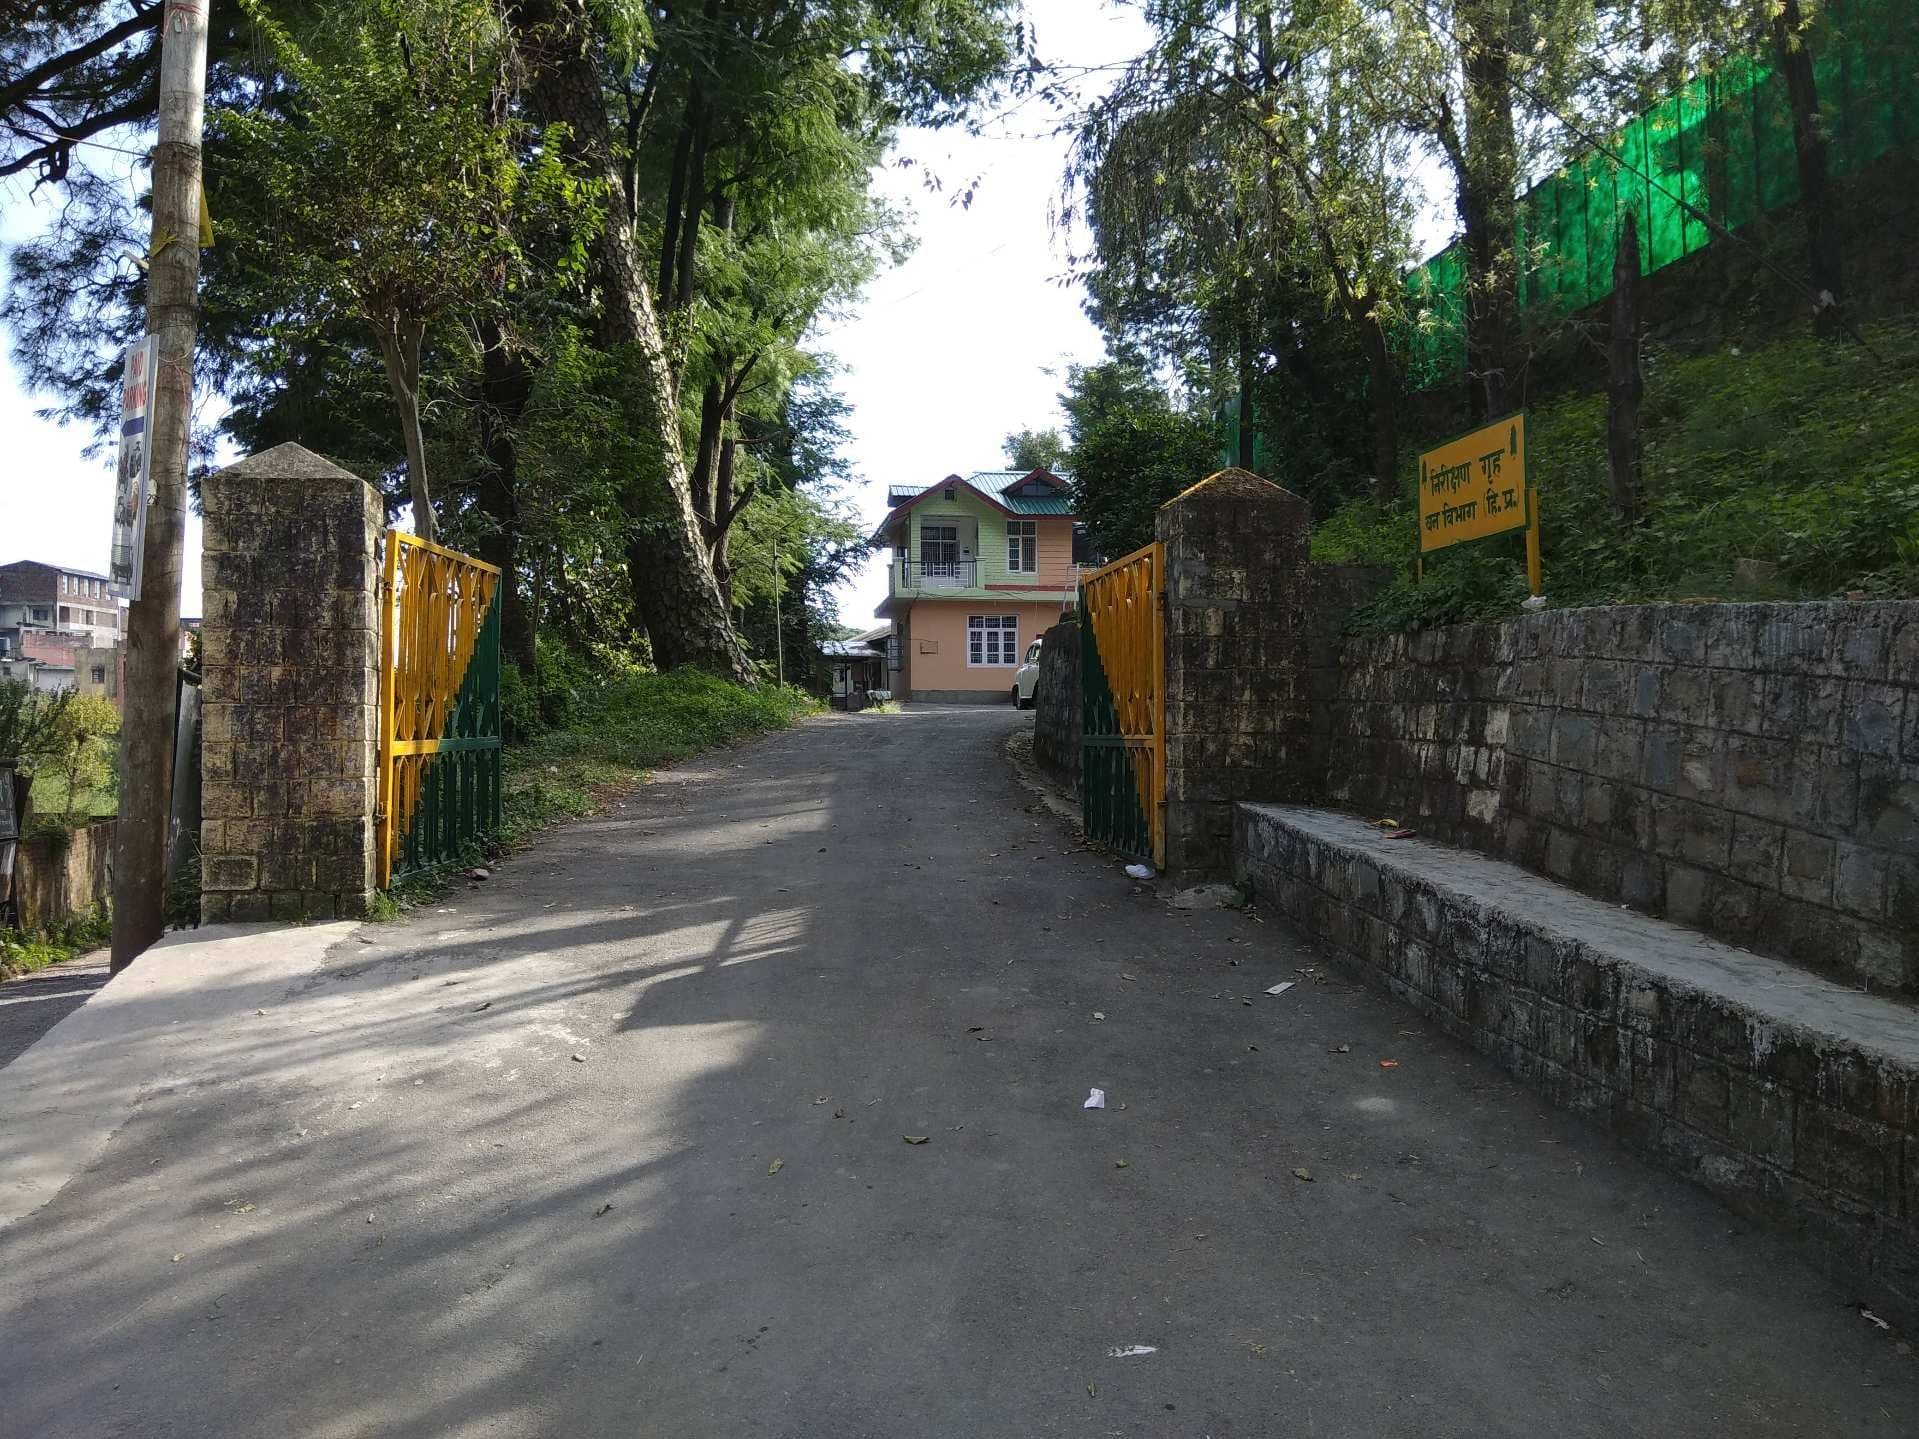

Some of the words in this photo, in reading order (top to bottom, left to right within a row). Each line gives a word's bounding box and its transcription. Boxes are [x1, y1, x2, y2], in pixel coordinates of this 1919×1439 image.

[131, 351, 143, 378] PAID
[123, 384, 146, 410] PARKING
[1479, 448, 1505, 484] गृह
[1441, 501, 1477, 528] विभाग
